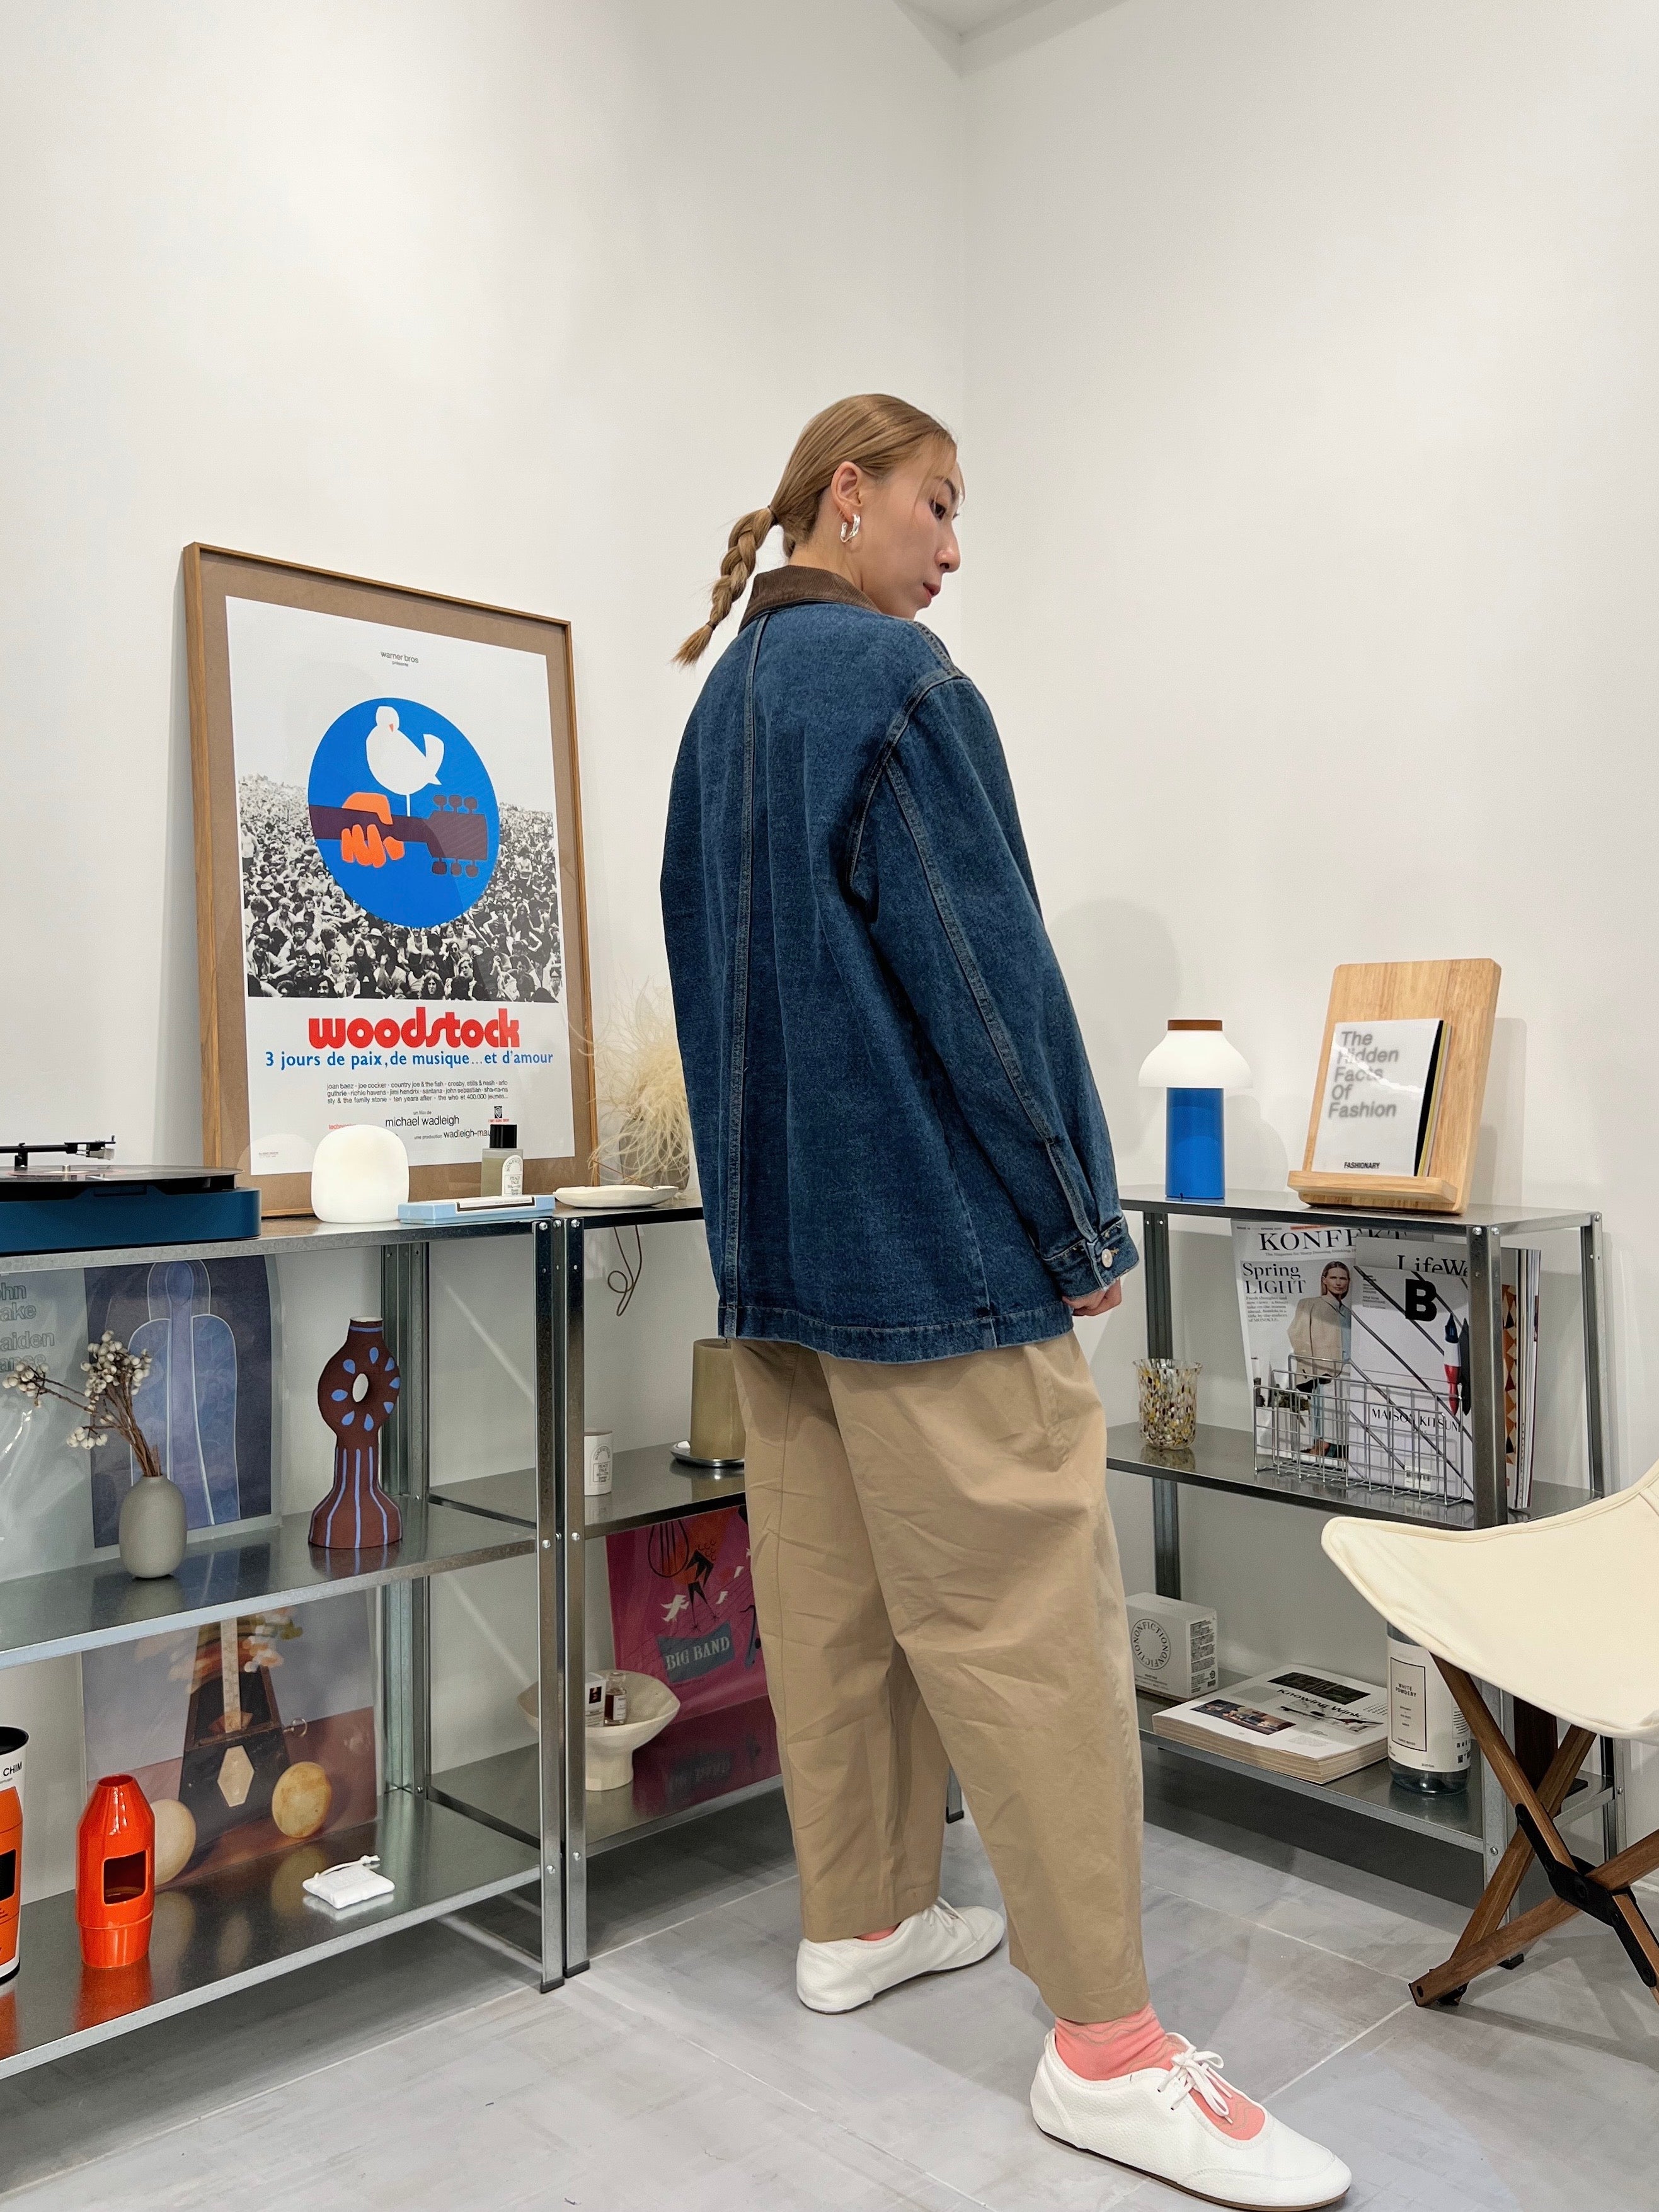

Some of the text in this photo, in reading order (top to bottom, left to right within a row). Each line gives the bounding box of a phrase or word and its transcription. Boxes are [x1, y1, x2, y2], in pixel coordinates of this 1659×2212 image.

[381, 652, 418, 663] warner bros
[309, 1007, 520, 1049] woodstock
[1341, 1031, 1373, 1046] The
[265, 1052, 274, 1066] 3
[281, 1051, 321, 1070] jours
[327, 1051, 345, 1066] de
[502, 1050, 554, 1064] d'amour
[1331, 1084, 1354, 1100] Of
[1328, 1101, 1397, 1119] Fashion
[385, 1115, 459, 1127] michael wadleigh
[1243, 1262, 1300, 1280] Spring
[0, 1282, 26, 1301] hn
[1245, 1280, 1306, 1294] LIGHT
[1405, 1278, 1437, 1322] B
[665, 1637, 730, 1670] BIG BAND
[1395, 1686, 1416, 1697] POWDERY
[1398, 1683, 1413, 1691] WHITE
[1277, 1689, 1330, 1708] Knowing
[1331, 1706, 1362, 1718] Wink
